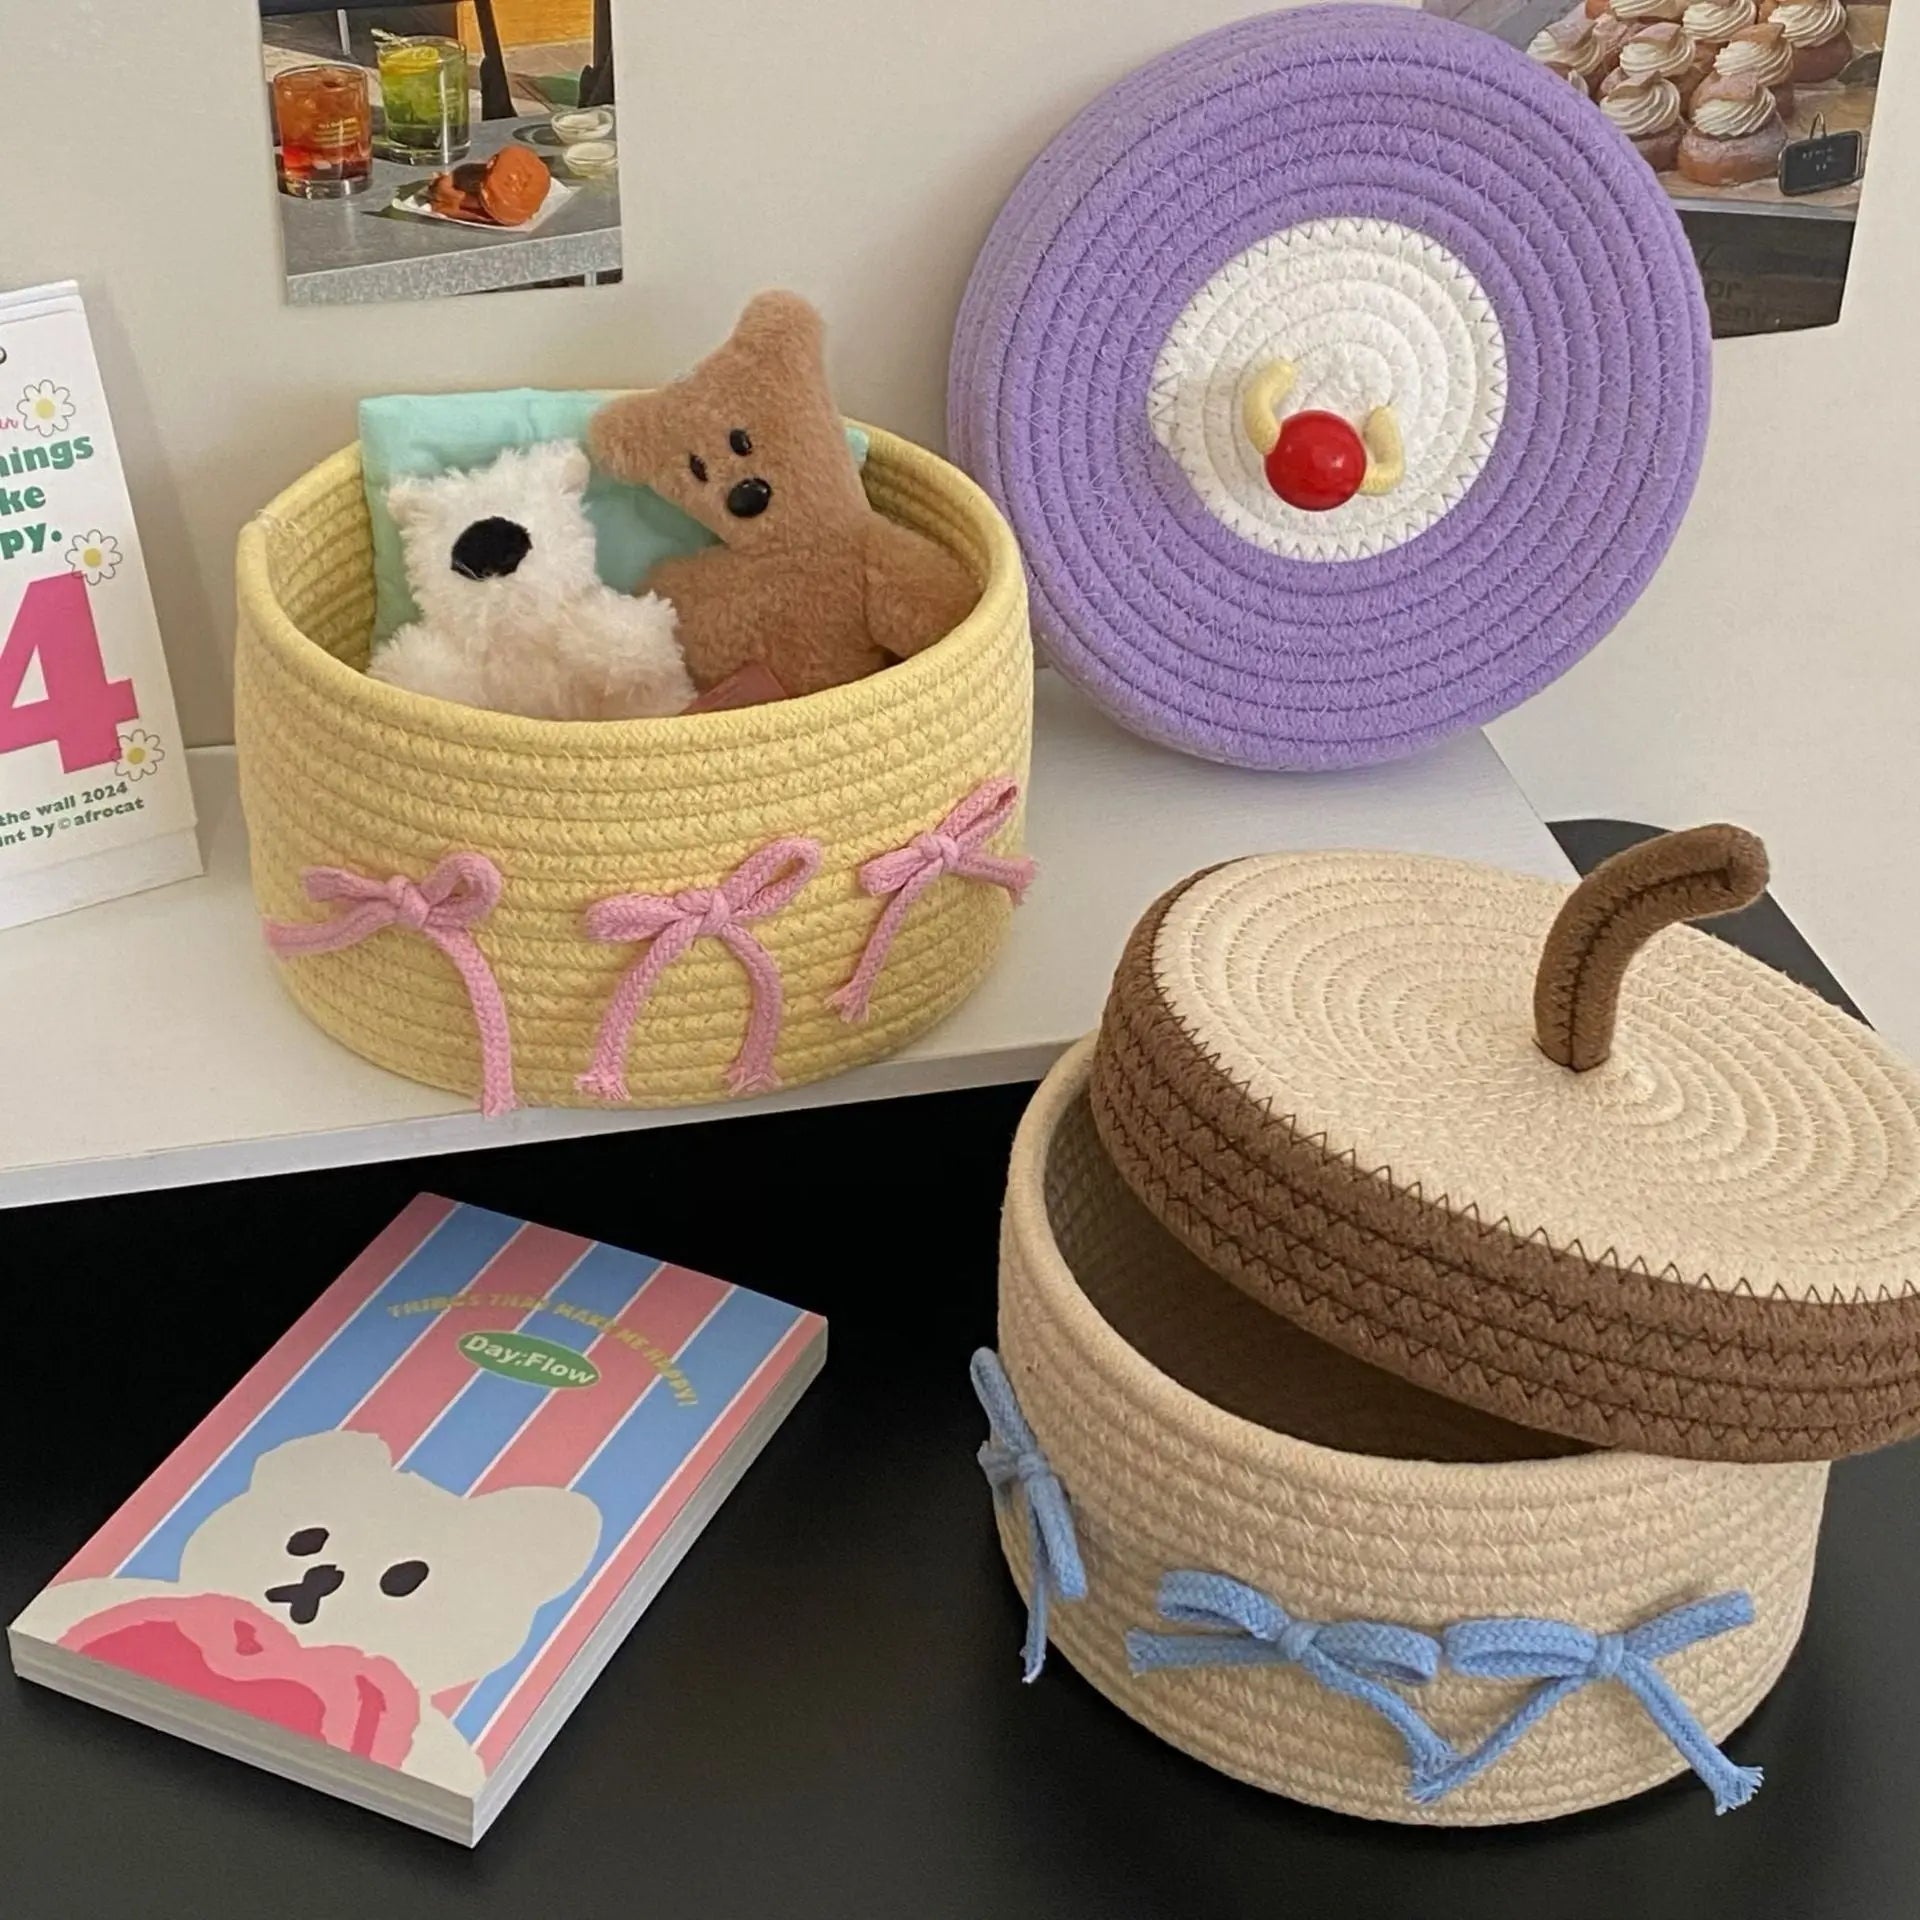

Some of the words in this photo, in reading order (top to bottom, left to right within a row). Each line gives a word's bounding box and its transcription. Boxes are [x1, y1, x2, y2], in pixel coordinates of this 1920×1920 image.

[0, 485, 46, 516] ke
[0, 522, 62, 560] py.
[0, 570, 139, 774] 4
[36, 795, 76, 816] wall
[81, 781, 128, 804] 2024
